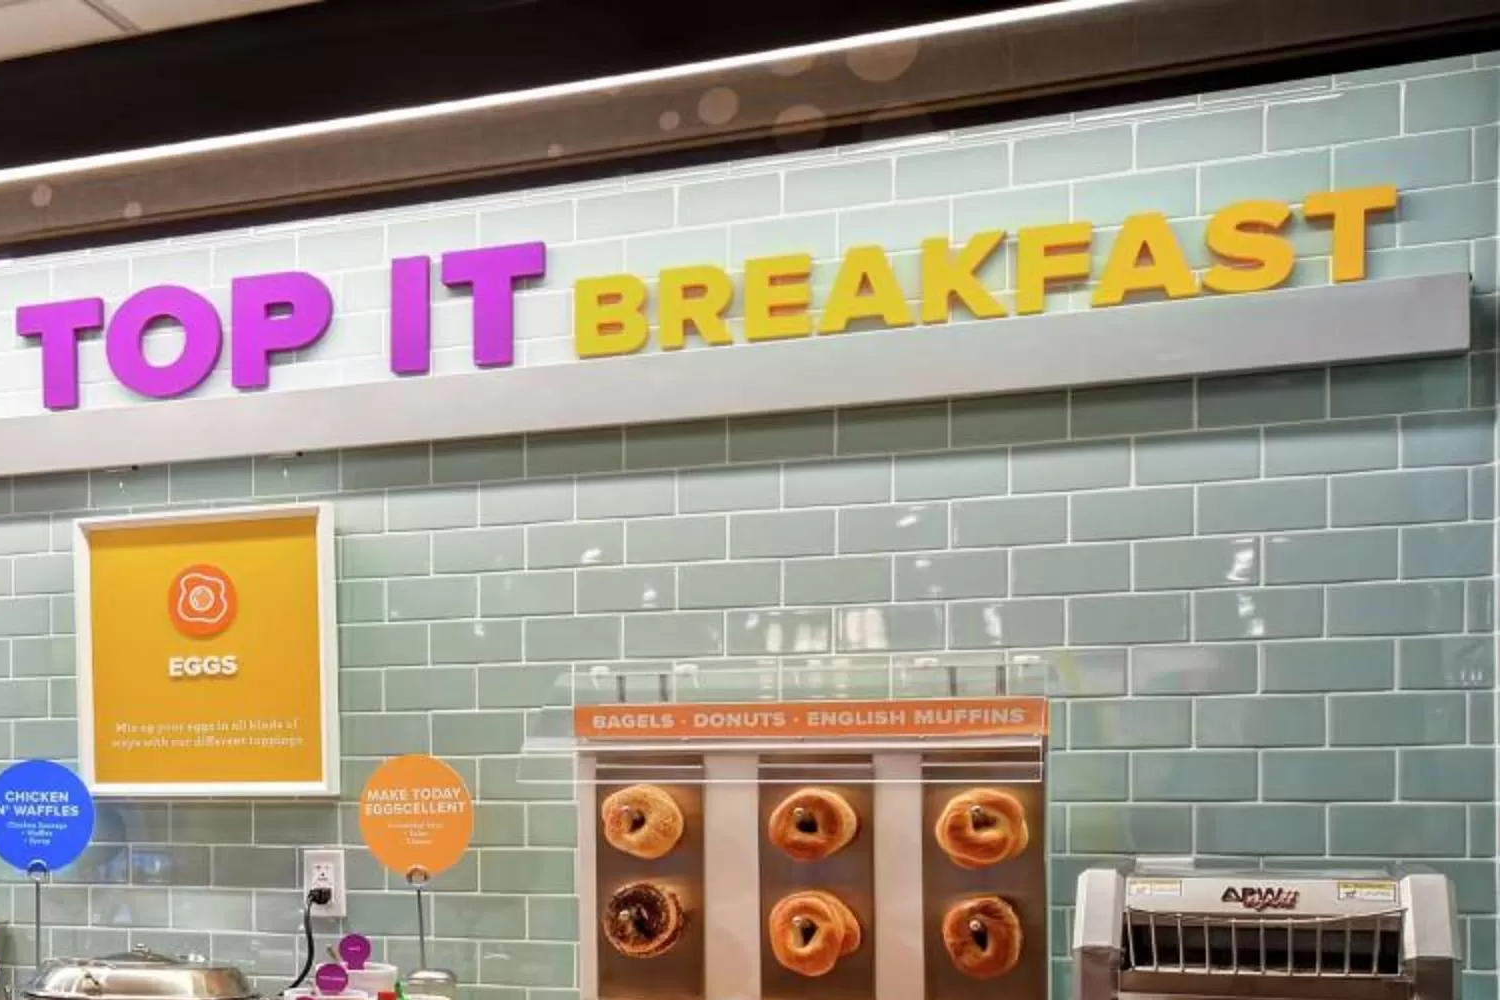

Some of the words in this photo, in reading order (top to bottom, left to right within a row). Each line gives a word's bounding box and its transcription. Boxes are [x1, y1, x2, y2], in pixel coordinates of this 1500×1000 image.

[16, 271, 333, 411] TOP
[390, 241, 547, 375] IT
[574, 185, 1398, 359] BREAKFAST
[168, 655, 238, 677] EGGS
[592, 713, 675, 729] BAGELS
[693, 711, 786, 728] DONUTS
[807, 711, 905, 727] ENGLISH
[914, 707, 1025, 724] MUFFINS
[4, 791, 69, 803] CHICKEN
[367, 788, 406, 801] MAKE
[411, 787, 461, 800] TODAY
[14, 805, 80, 817] WAFFLES
[365, 802, 467, 816] EGGSCELLENT
[1221, 886, 1284, 902] APW
